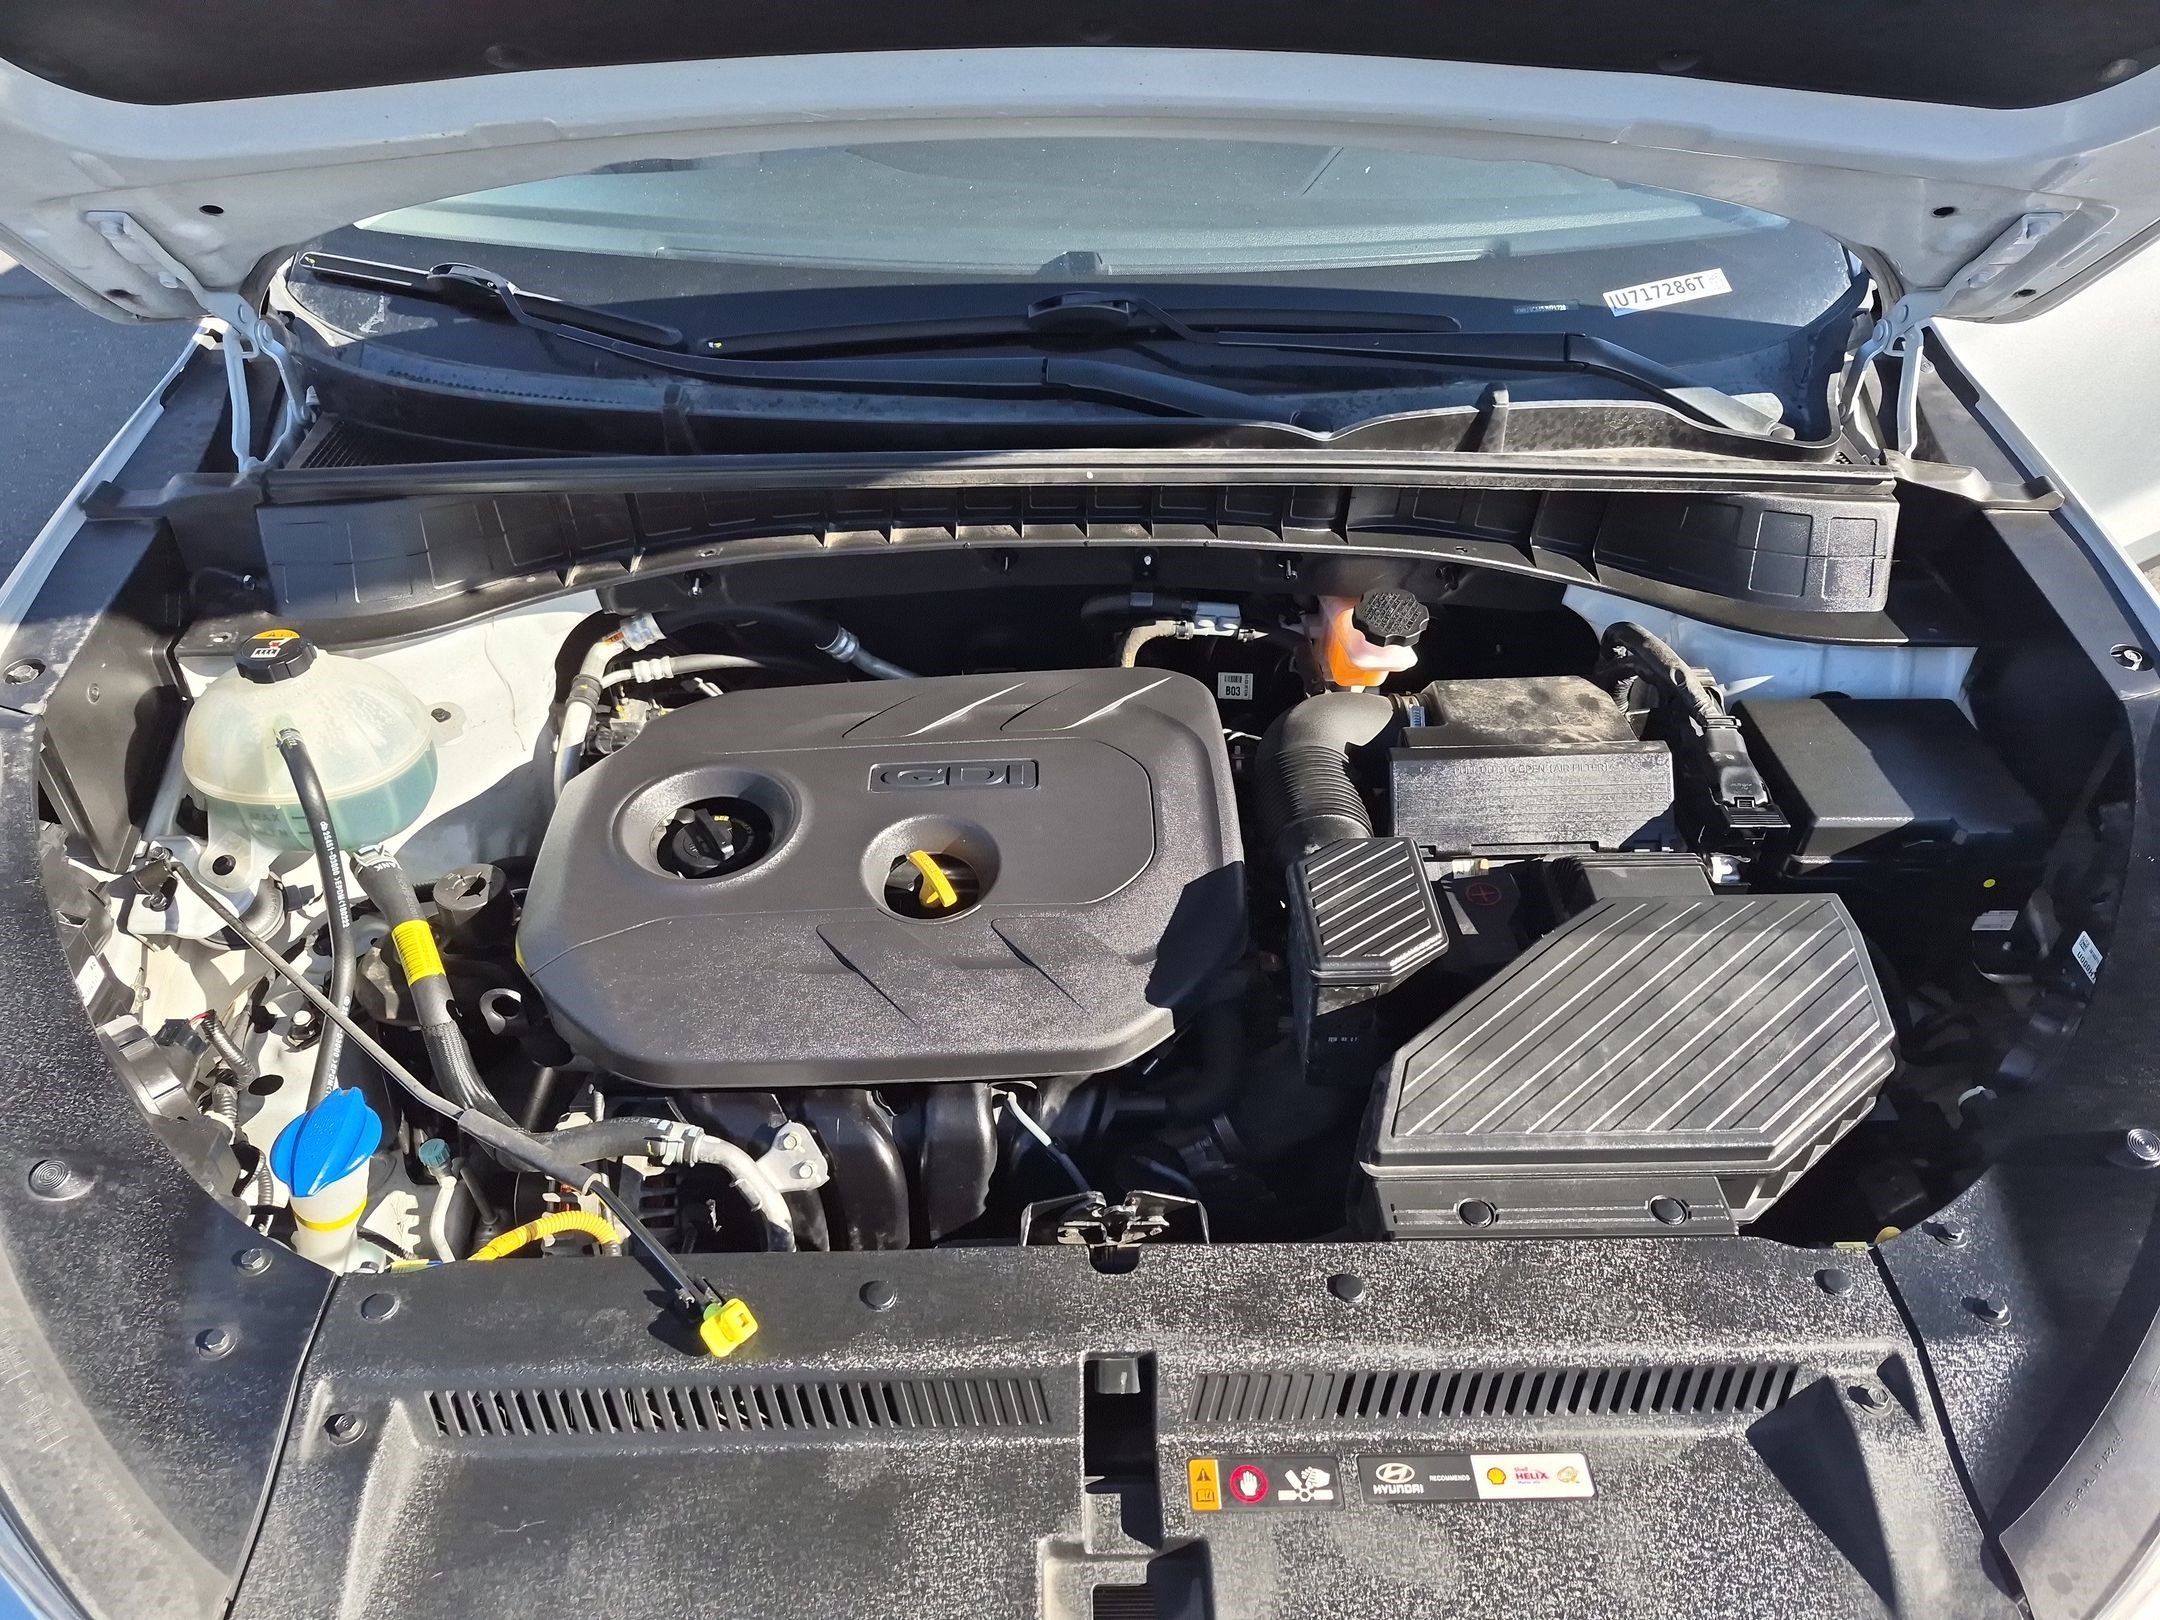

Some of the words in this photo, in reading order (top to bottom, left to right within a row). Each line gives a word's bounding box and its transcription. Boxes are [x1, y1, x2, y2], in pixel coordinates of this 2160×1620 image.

[1226, 686, 1241, 696] B03
[880, 764, 1025, 787] GDI
[1429, 1474, 1471, 1482] RECOMMENDS
[1515, 1471, 1549, 1480] HELIX
[1373, 1483, 1425, 1495] HYUNDAI
